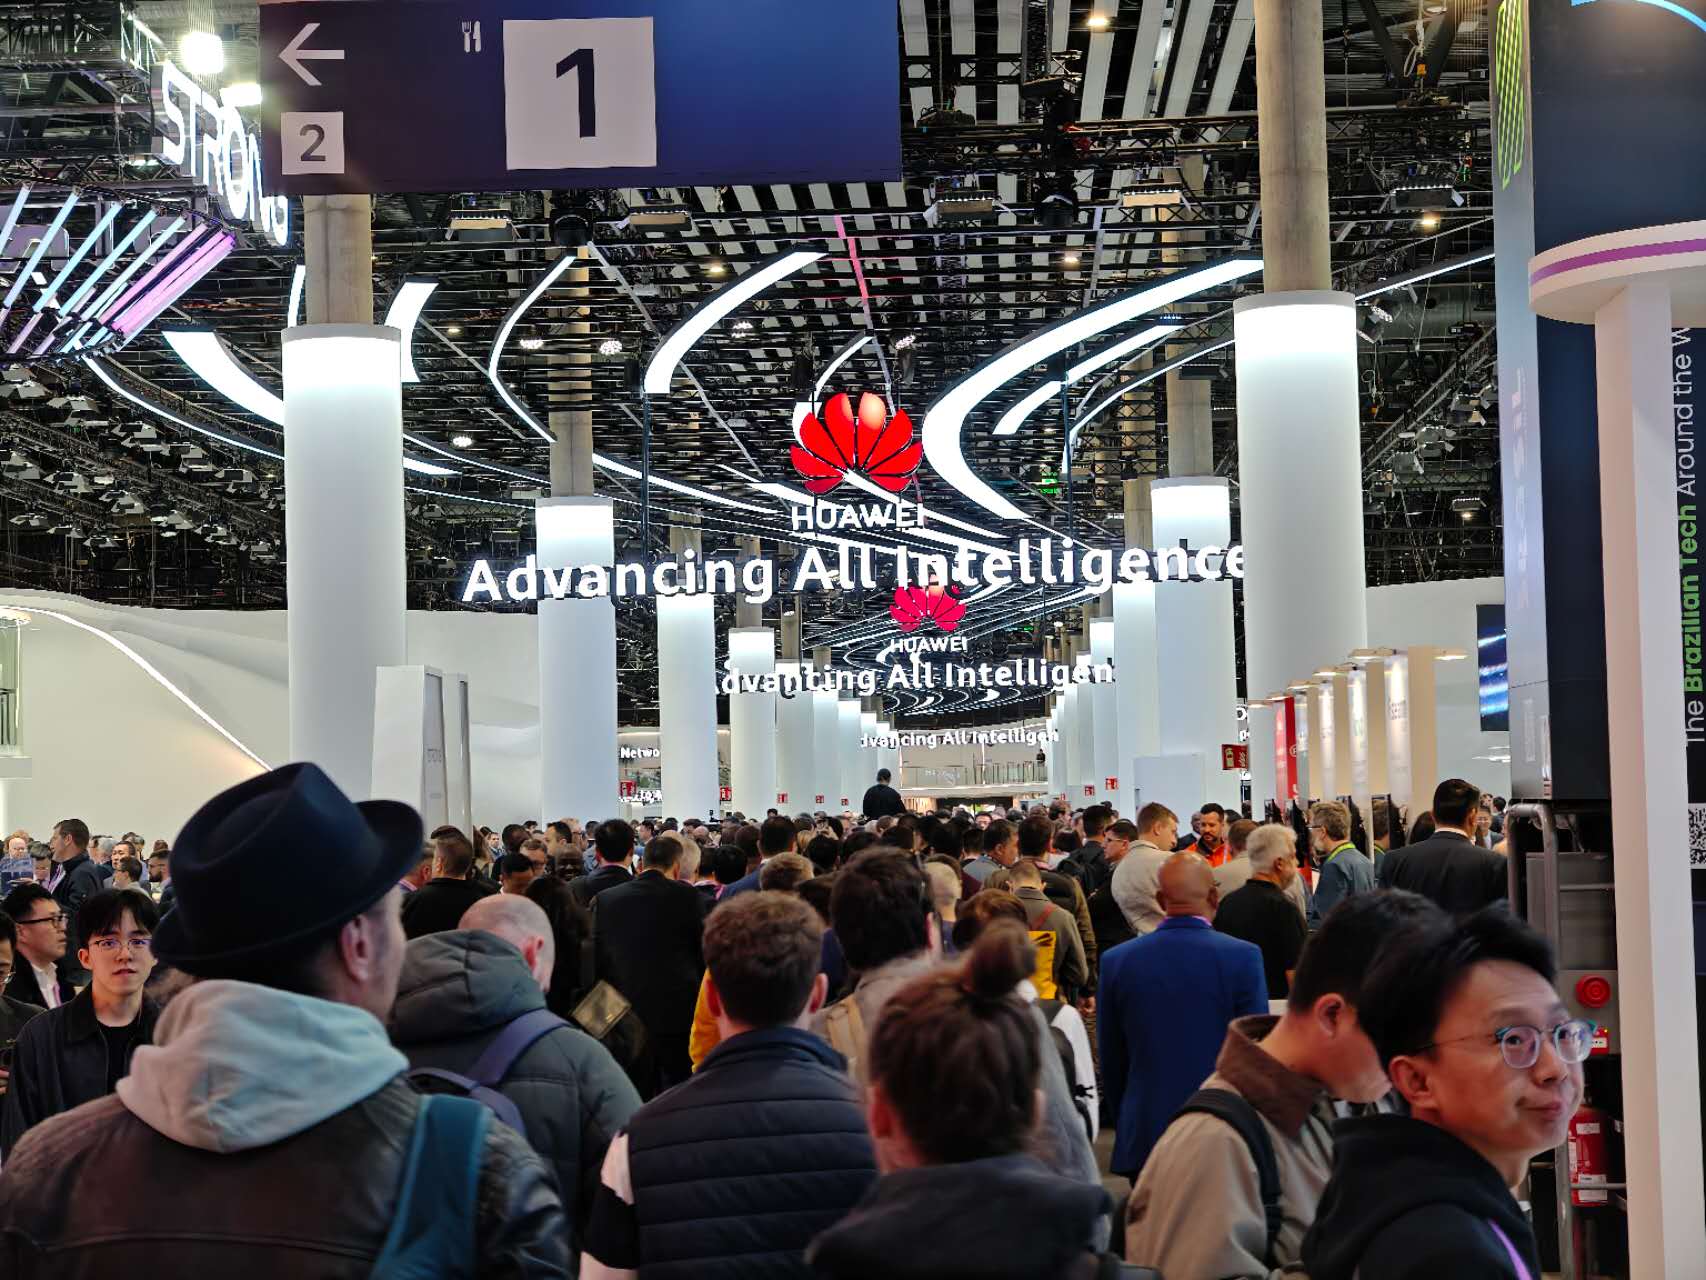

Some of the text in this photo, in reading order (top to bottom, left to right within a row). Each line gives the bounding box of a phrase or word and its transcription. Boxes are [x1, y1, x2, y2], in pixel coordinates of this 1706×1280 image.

[556, 48, 597, 138] 1
[299, 124, 327, 162] 2
[1672, 354, 1693, 396] the
[1674, 404, 1696, 497] Around
[791, 503, 924, 530] HUAWEI
[1679, 504, 1699, 570] Tech
[462, 537, 1244, 604] Advancing All Intelligence
[890, 636, 968, 653] HUAWEI
[1682, 575, 1704, 692] Brazilian
[715, 664, 876, 696] dvancing
[886, 659, 935, 688] All
[942, 730, 968, 745] All
